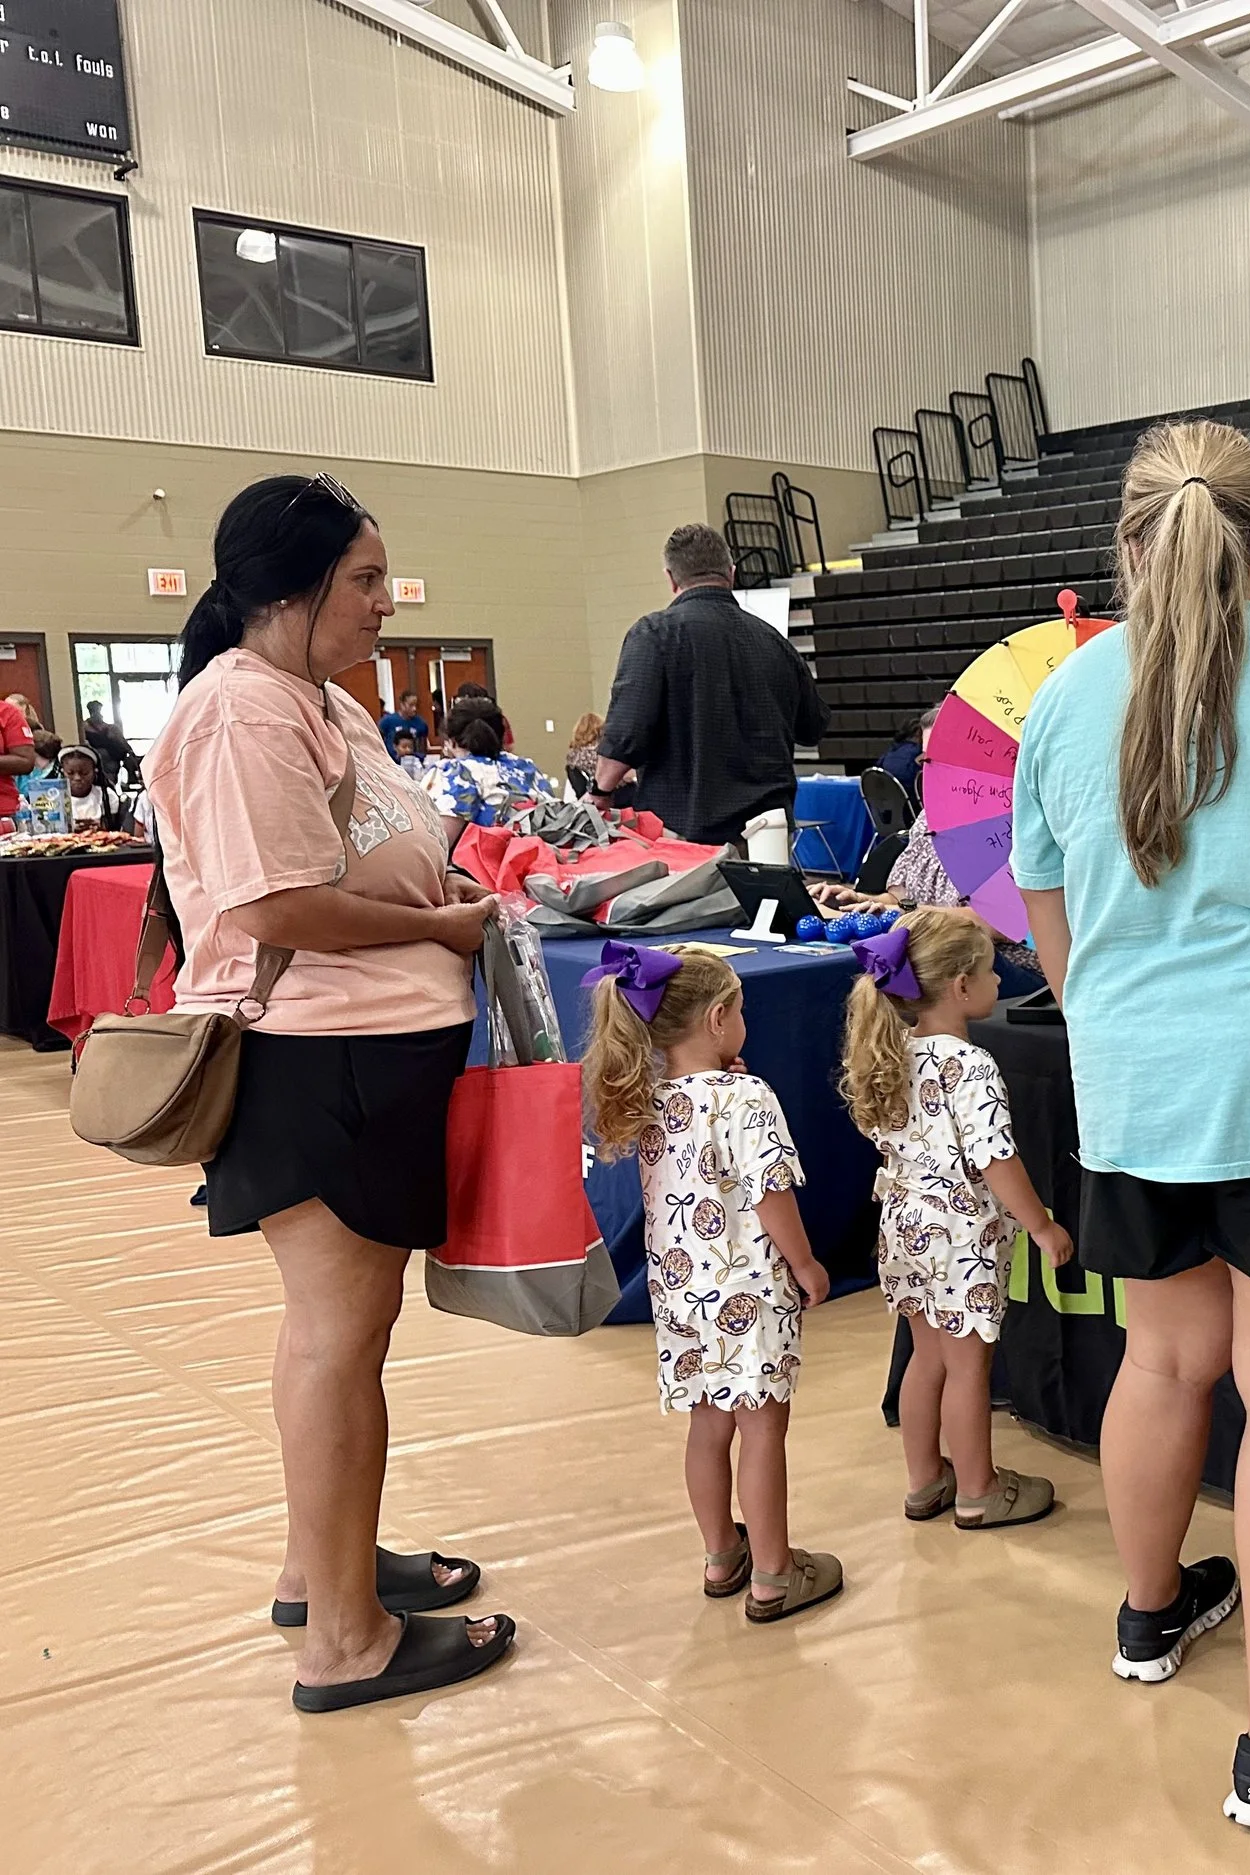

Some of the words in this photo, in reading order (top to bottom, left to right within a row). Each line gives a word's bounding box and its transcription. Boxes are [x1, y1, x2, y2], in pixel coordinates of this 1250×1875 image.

[76, 54, 114, 78] fouls
[86, 121, 118, 141] won
[963, 1064, 996, 1083] LSU
[743, 1110, 777, 1131] LSU
[676, 1139, 698, 1180] LSU
